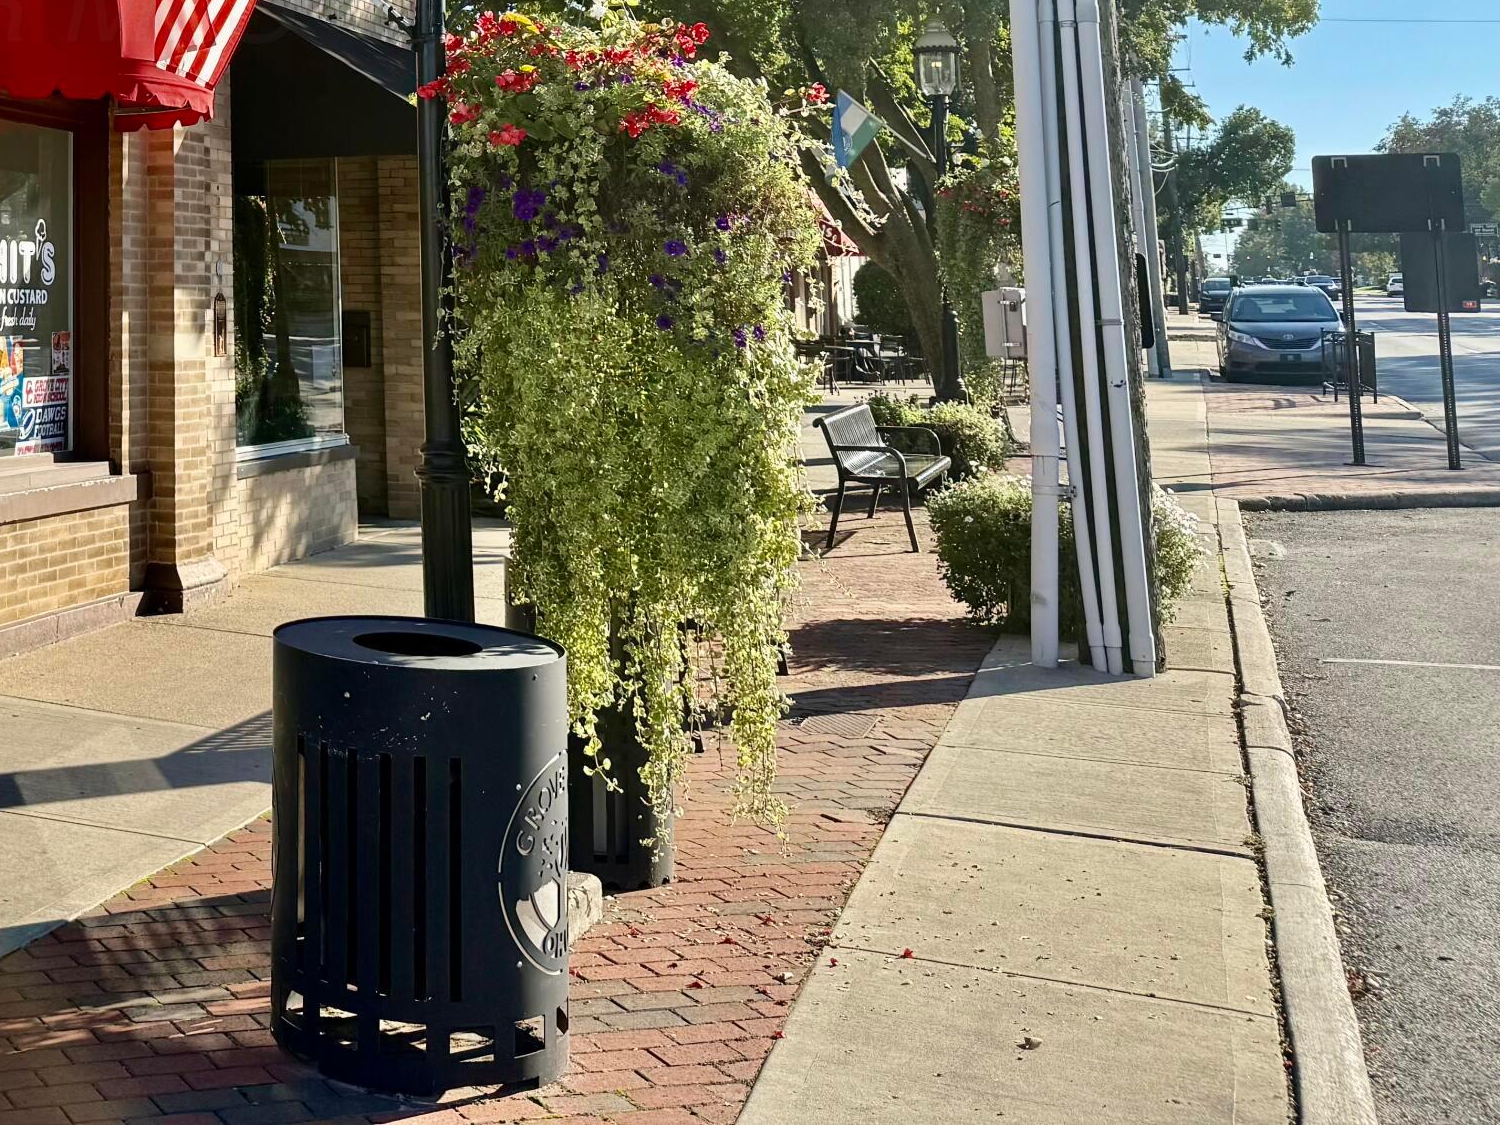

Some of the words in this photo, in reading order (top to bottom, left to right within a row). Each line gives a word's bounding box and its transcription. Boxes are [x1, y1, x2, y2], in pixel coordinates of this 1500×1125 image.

[7, 288, 48, 305] CUSTARD
[19, 306, 37, 331] daily
[36, 406, 67, 424] DAWGS
[34, 422, 65, 438] FOOTBALL
